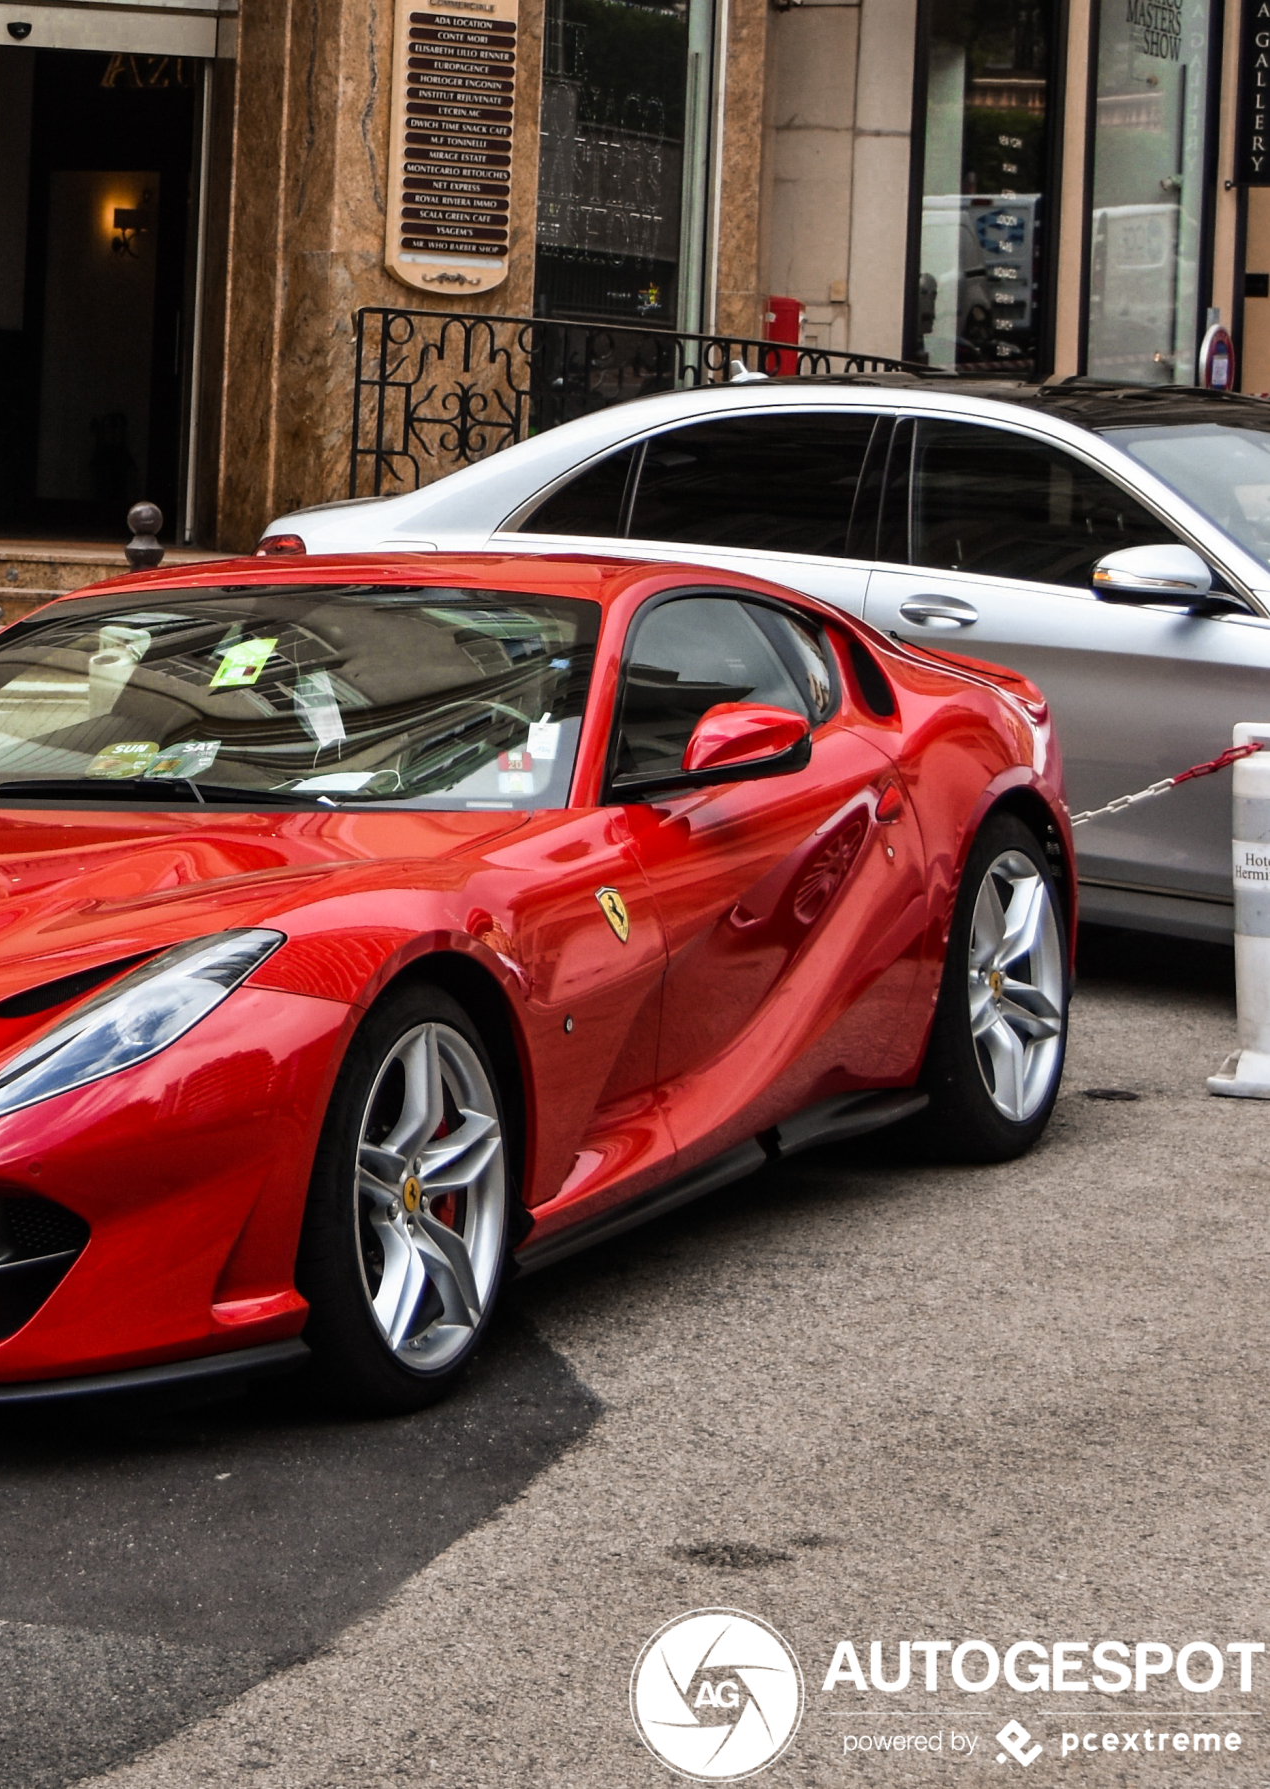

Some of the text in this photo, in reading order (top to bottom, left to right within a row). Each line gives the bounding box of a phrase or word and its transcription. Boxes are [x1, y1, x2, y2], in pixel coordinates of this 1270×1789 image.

[434, 16, 493, 29] ADA LOCATION
[1126, 0, 1182, 36] MASTERS
[437, 32, 488, 43] CONTE MORI
[1143, 29, 1182, 61] SHOW
[415, 44, 510, 60] ELISABETH LILLO RENNER
[434, 61, 489, 74] EUROPAGENCE
[420, 75, 502, 90] HORLOGER ENGONIN
[419, 90, 502, 105] INSTITUT REJUVENATE
[1251, 32, 1270, 172] GALLERY
[410, 119, 508, 135] DWICH TIME SNACK CAFE
[447, 138, 487, 148] TONINELLI
[429, 151, 487, 163] MIRAGE ESTATE
[406, 164, 508, 180] MONTECARLO RETOUCHES
[433, 181, 481, 192] NET EXPRESS
[415, 195, 497, 208] ROYAL RIVIERA IMMO
[420, 210, 491, 223] SCALA GREEN CAFE
[436, 226, 473, 236] YSAGEM'S
[412, 240, 499, 253] MR. WHO BARBER SHOP
[112, 744, 150, 754] SUN
[182, 742, 220, 753] SAT
